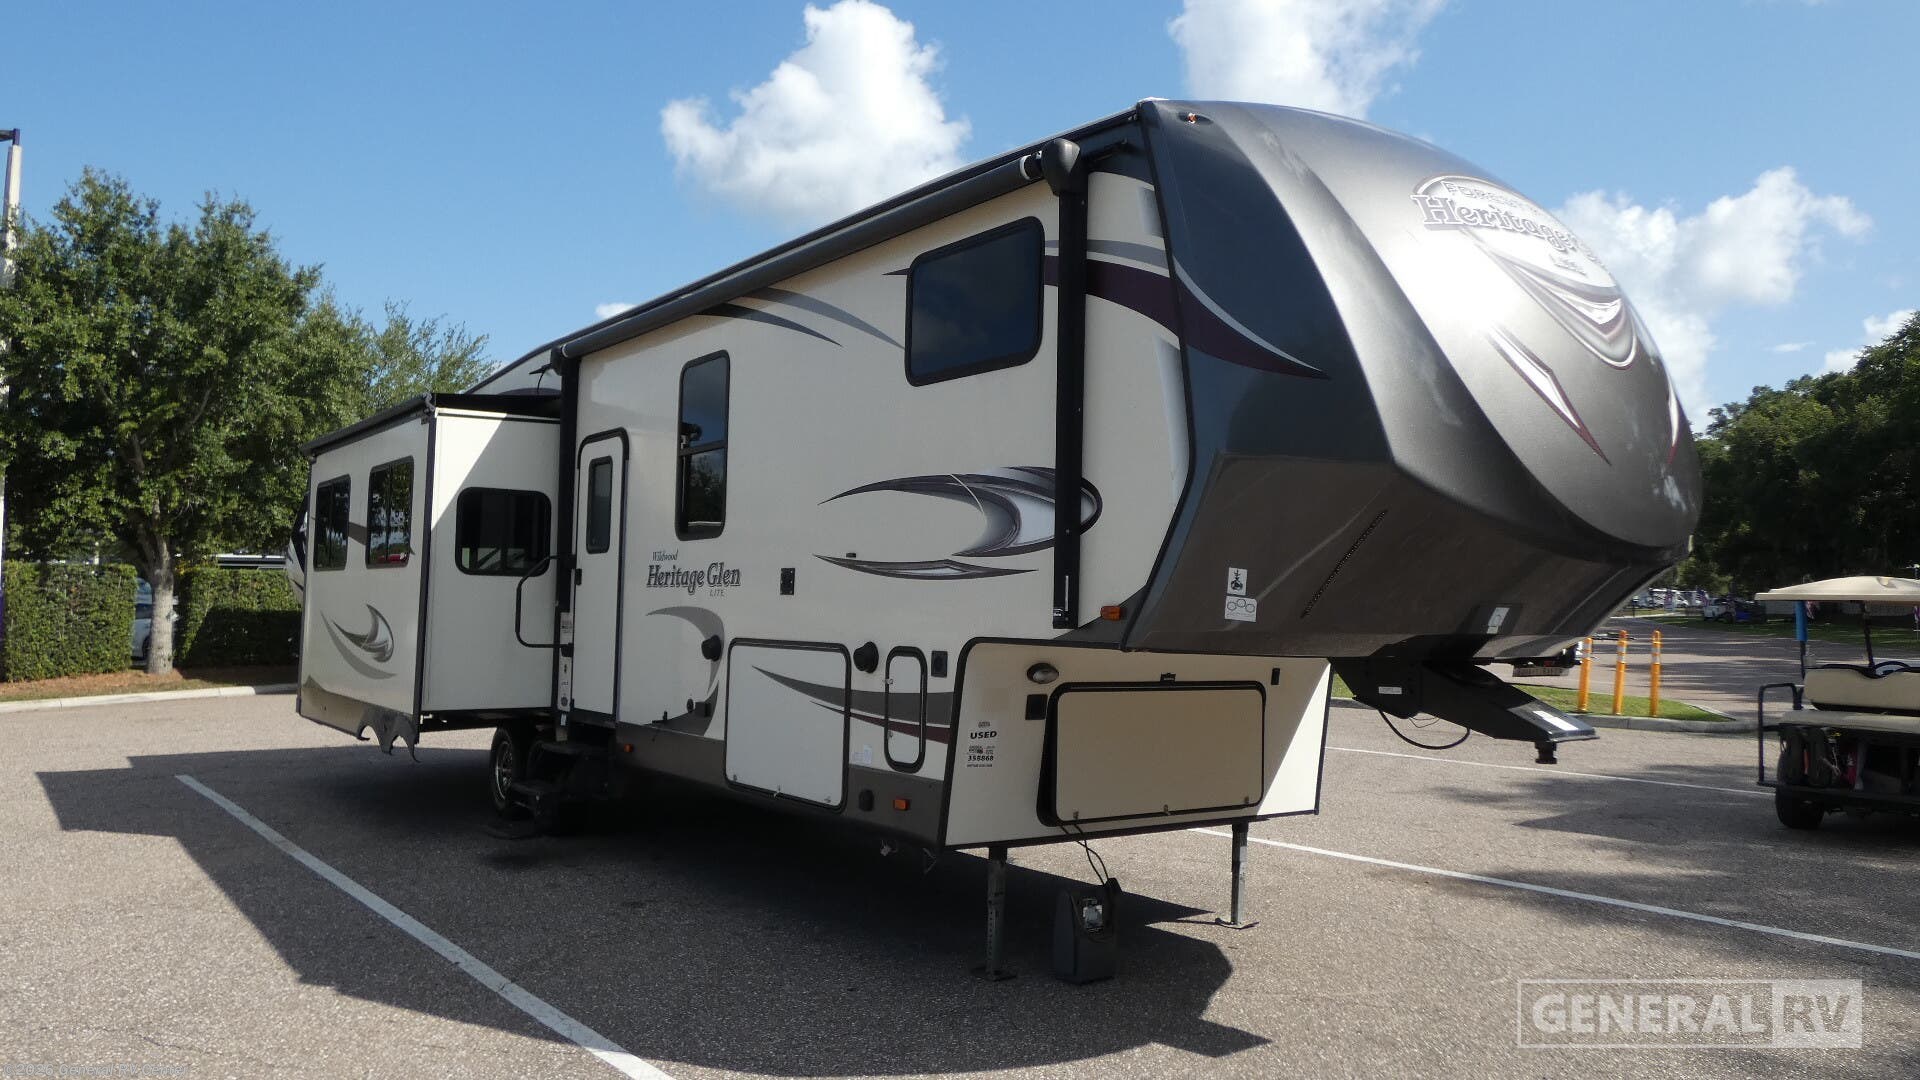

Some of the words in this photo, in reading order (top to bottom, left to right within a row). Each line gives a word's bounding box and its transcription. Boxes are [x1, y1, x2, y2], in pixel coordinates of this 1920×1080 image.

[1410, 194, 1577, 254] Heritage
[646, 564, 704, 595] Heritage
[706, 562, 742, 588] Glen
[709, 589, 725, 597] LITE
[970, 730, 998, 740] USED
